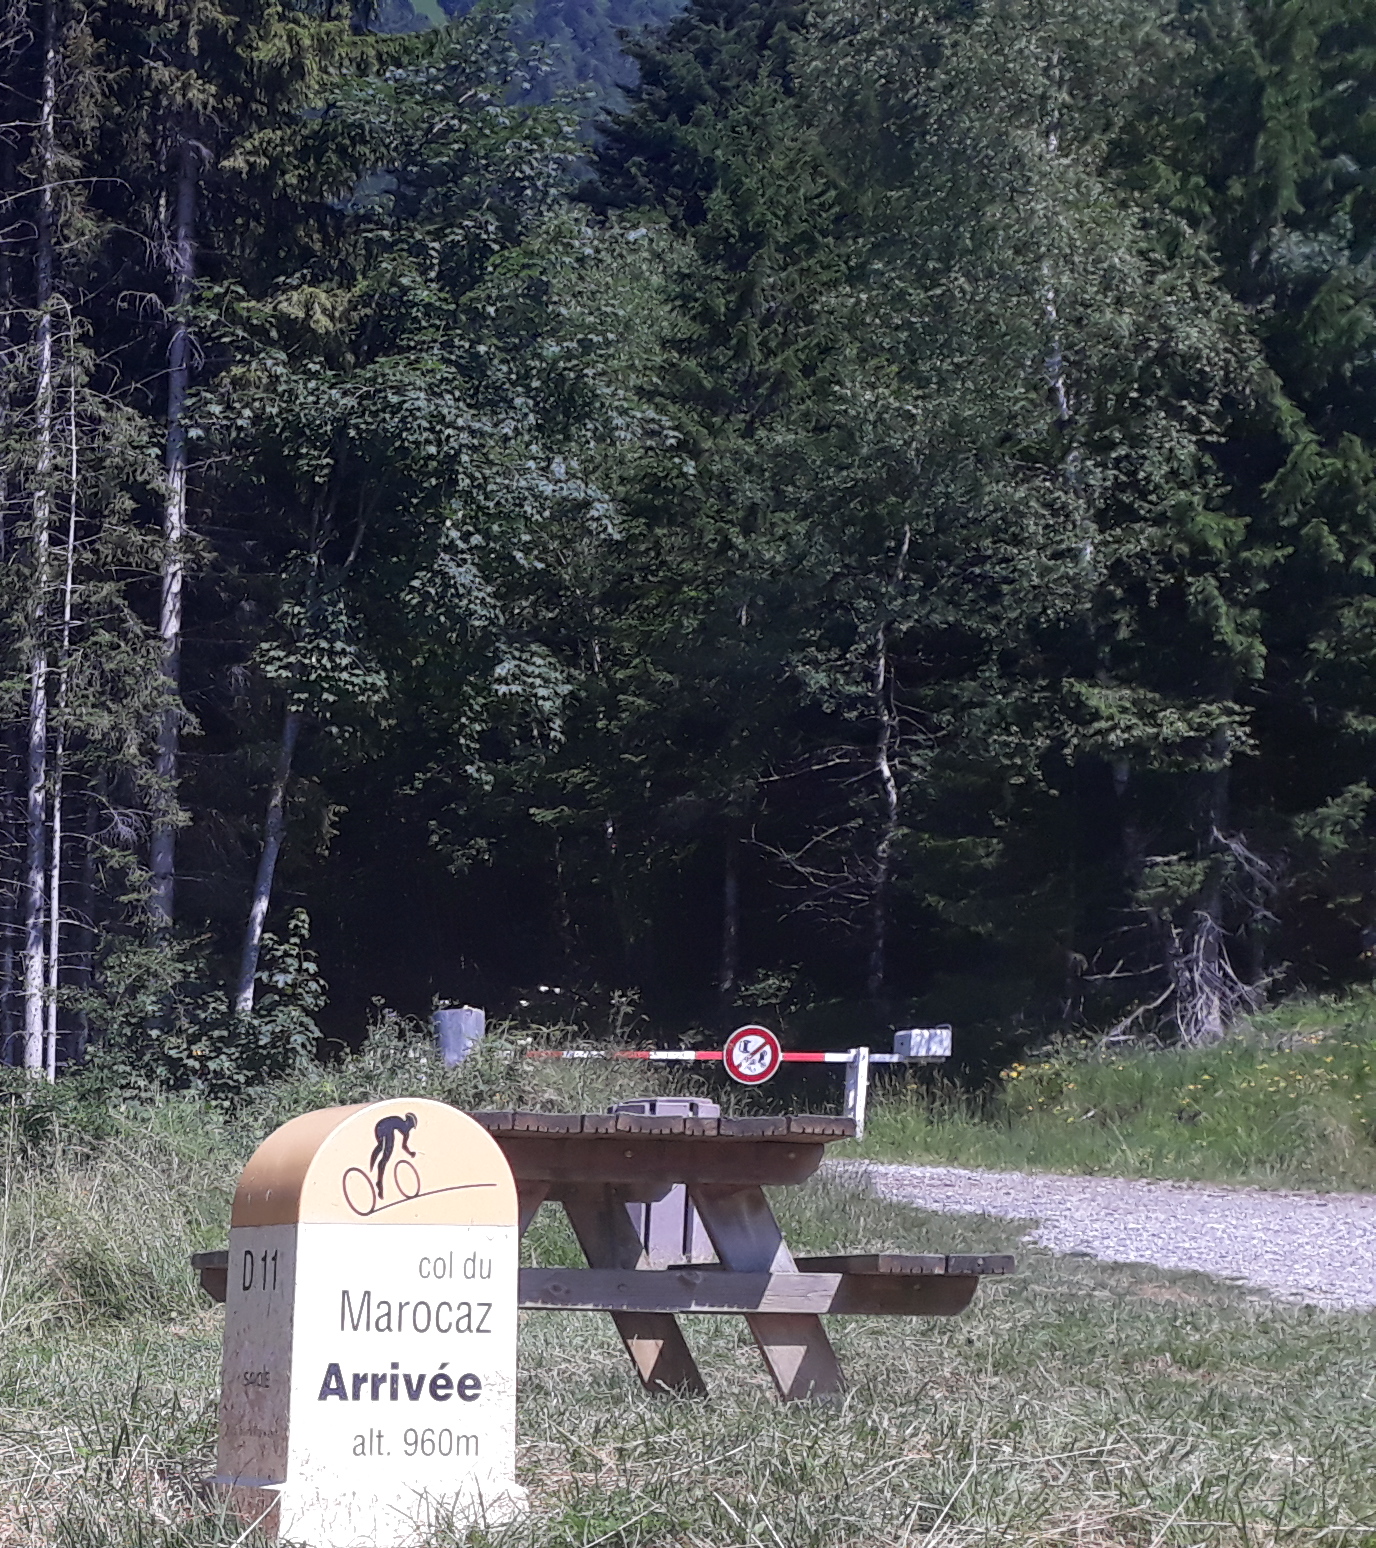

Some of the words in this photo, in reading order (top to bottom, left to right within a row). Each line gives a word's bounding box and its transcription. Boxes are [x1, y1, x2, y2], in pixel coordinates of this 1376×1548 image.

[418, 1251, 454, 1280] col
[463, 1250, 492, 1280] du
[340, 1289, 493, 1333] Marocaz
[317, 1361, 483, 1402] Arrivée
[352, 1428, 392, 1457] alt.
[402, 1427, 480, 1457] 960m
